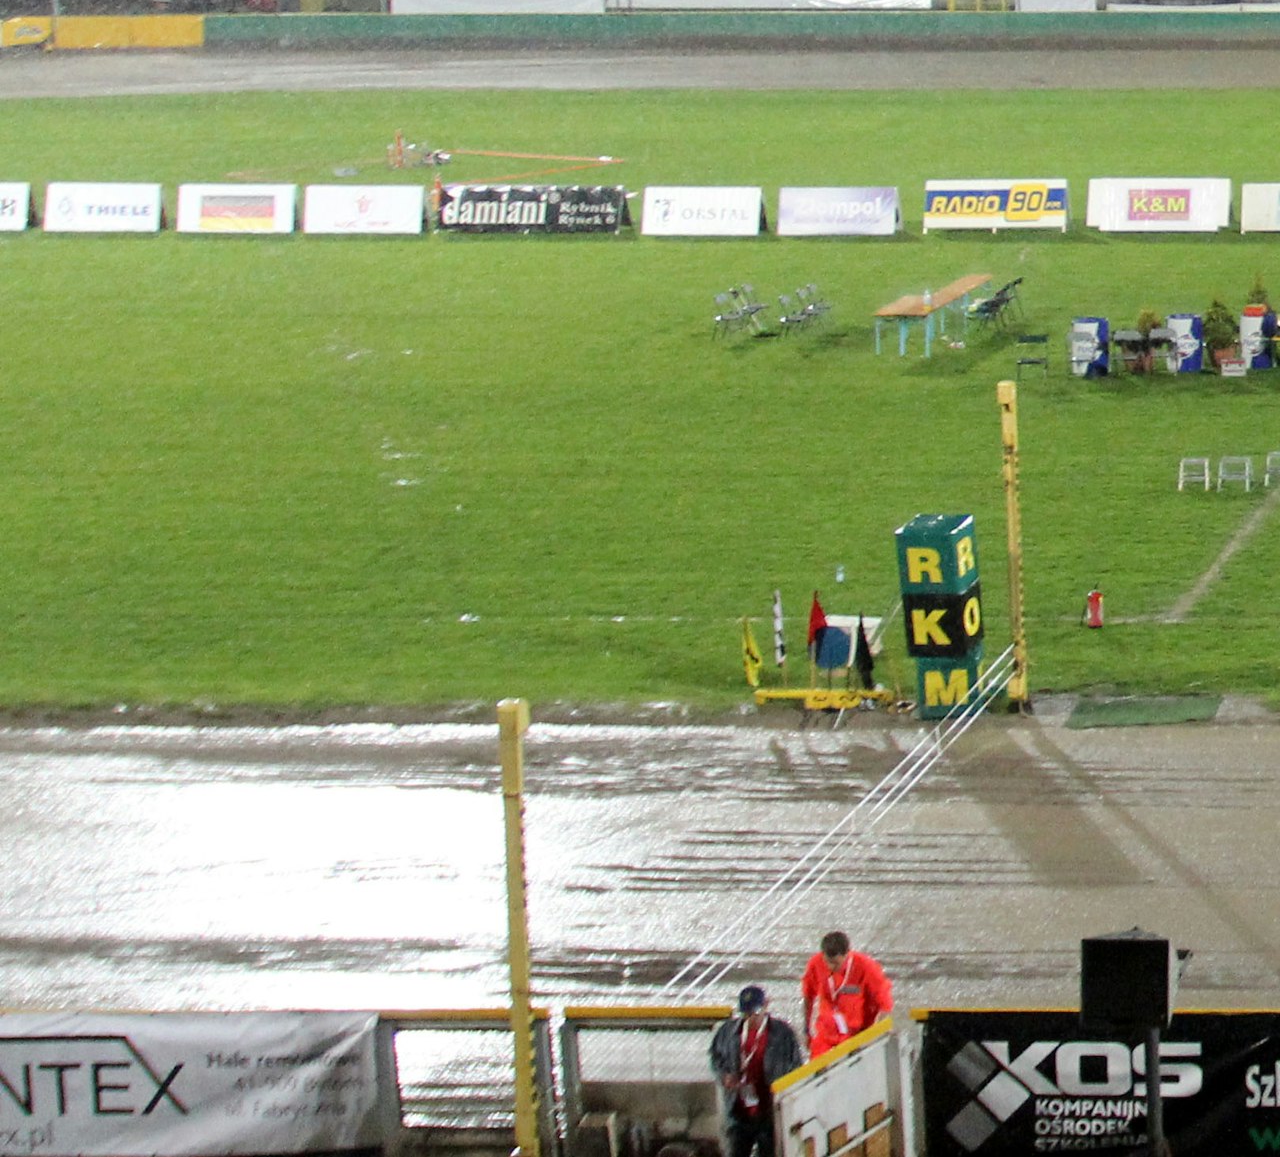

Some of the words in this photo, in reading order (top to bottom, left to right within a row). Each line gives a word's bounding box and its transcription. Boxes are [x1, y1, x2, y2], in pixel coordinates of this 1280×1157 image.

[86, 204, 152, 217] THIELE
[441, 189, 548, 226] damiani
[559, 200, 616, 215] Rybnik
[1009, 191, 1044, 212] 90
[1132, 197, 1186, 213] K&M
[981, 1040, 1204, 1099] KOS
[1035, 1117, 1131, 1136] OŚRODEK
